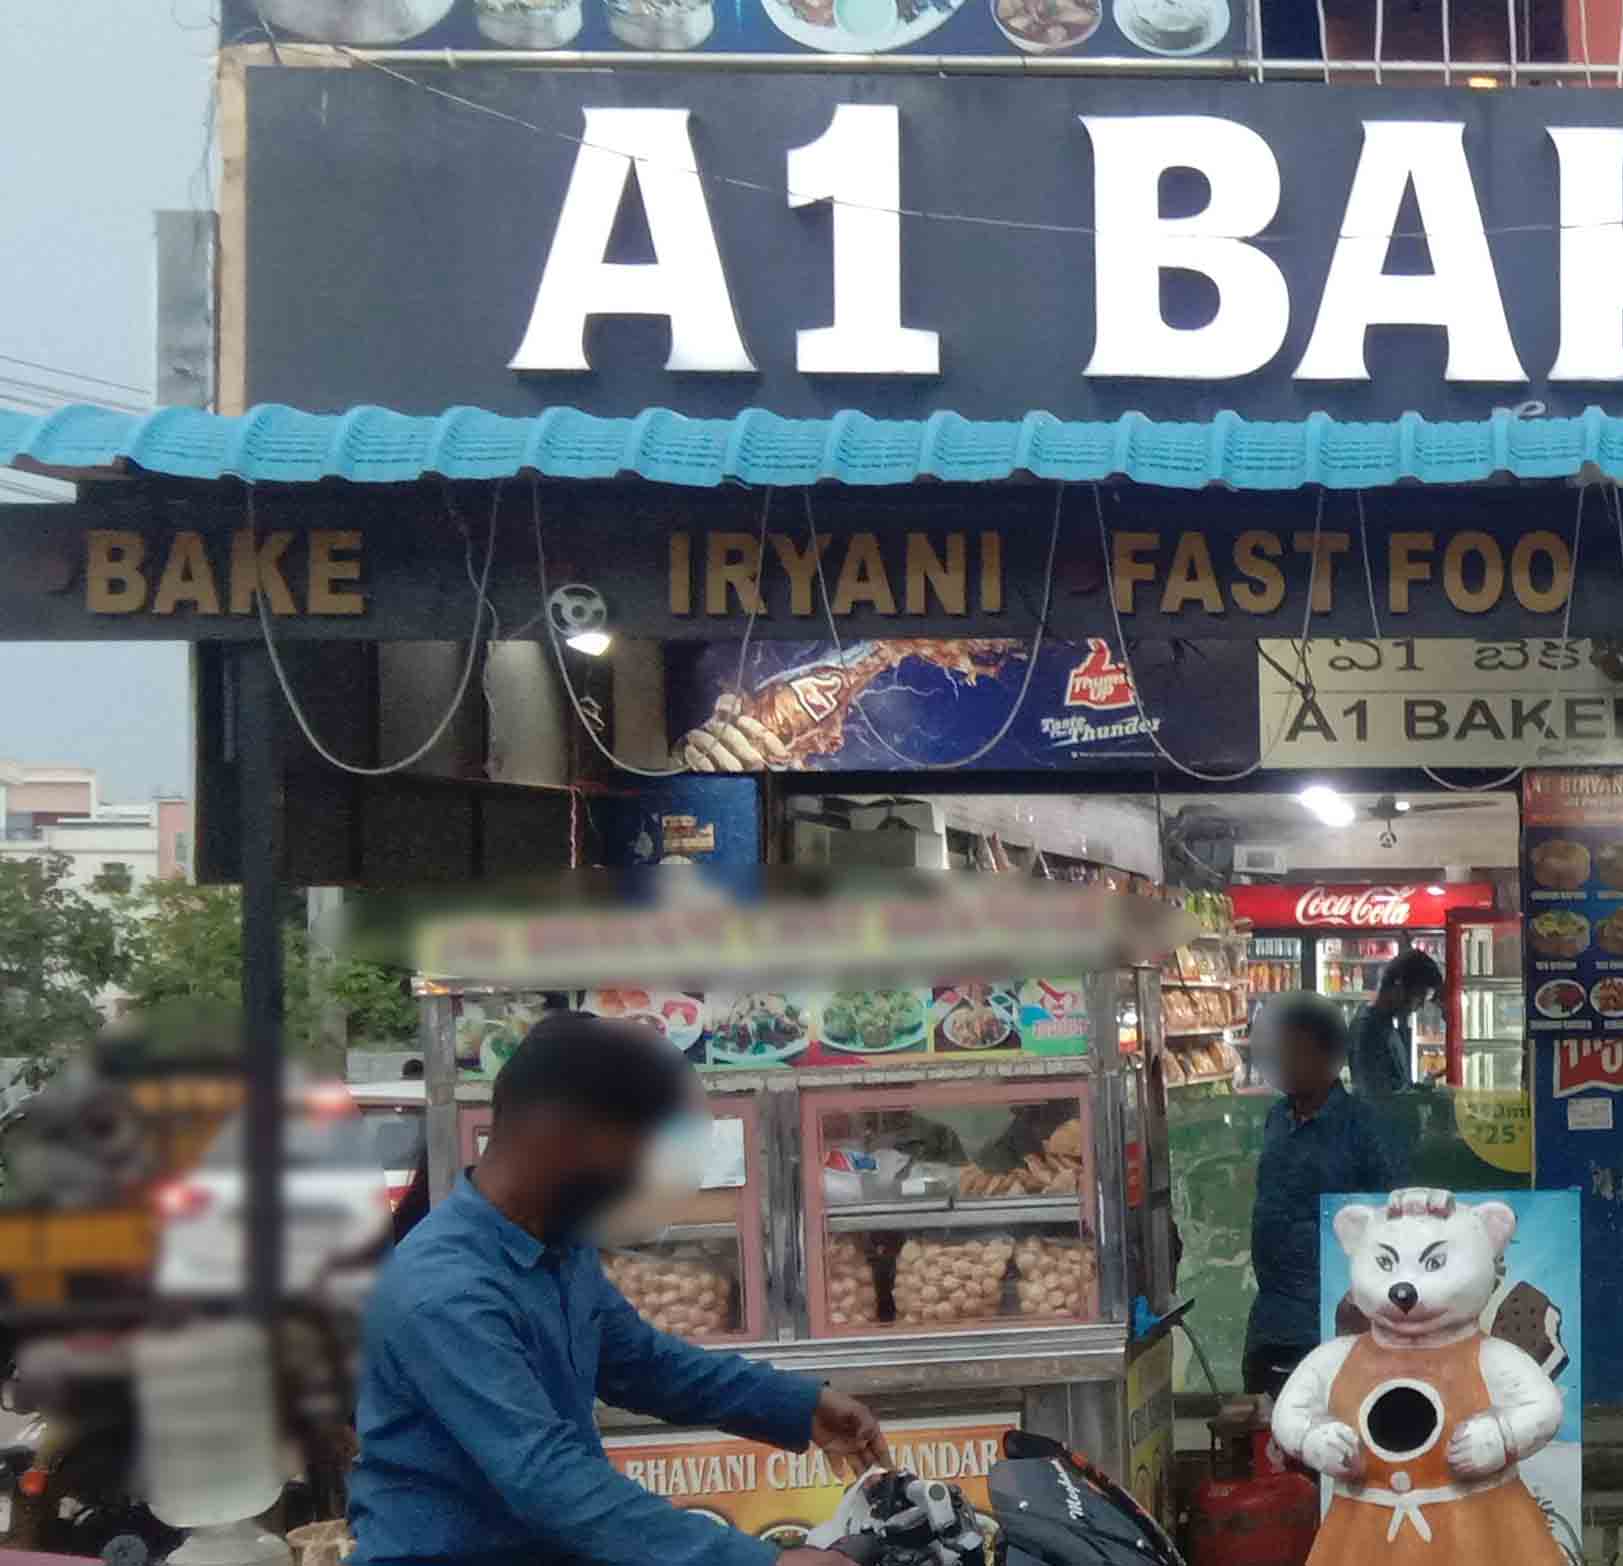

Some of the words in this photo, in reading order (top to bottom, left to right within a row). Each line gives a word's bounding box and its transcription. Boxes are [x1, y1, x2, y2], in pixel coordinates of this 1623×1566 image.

[507, 104, 941, 374] A1
[84, 529, 366, 617] BAKE
[1111, 529, 1350, 617] FAST
[1388, 529, 1572, 616] FOO
[1285, 696, 1371, 743] A1
[625, 1453, 757, 1497] BHAVANI
